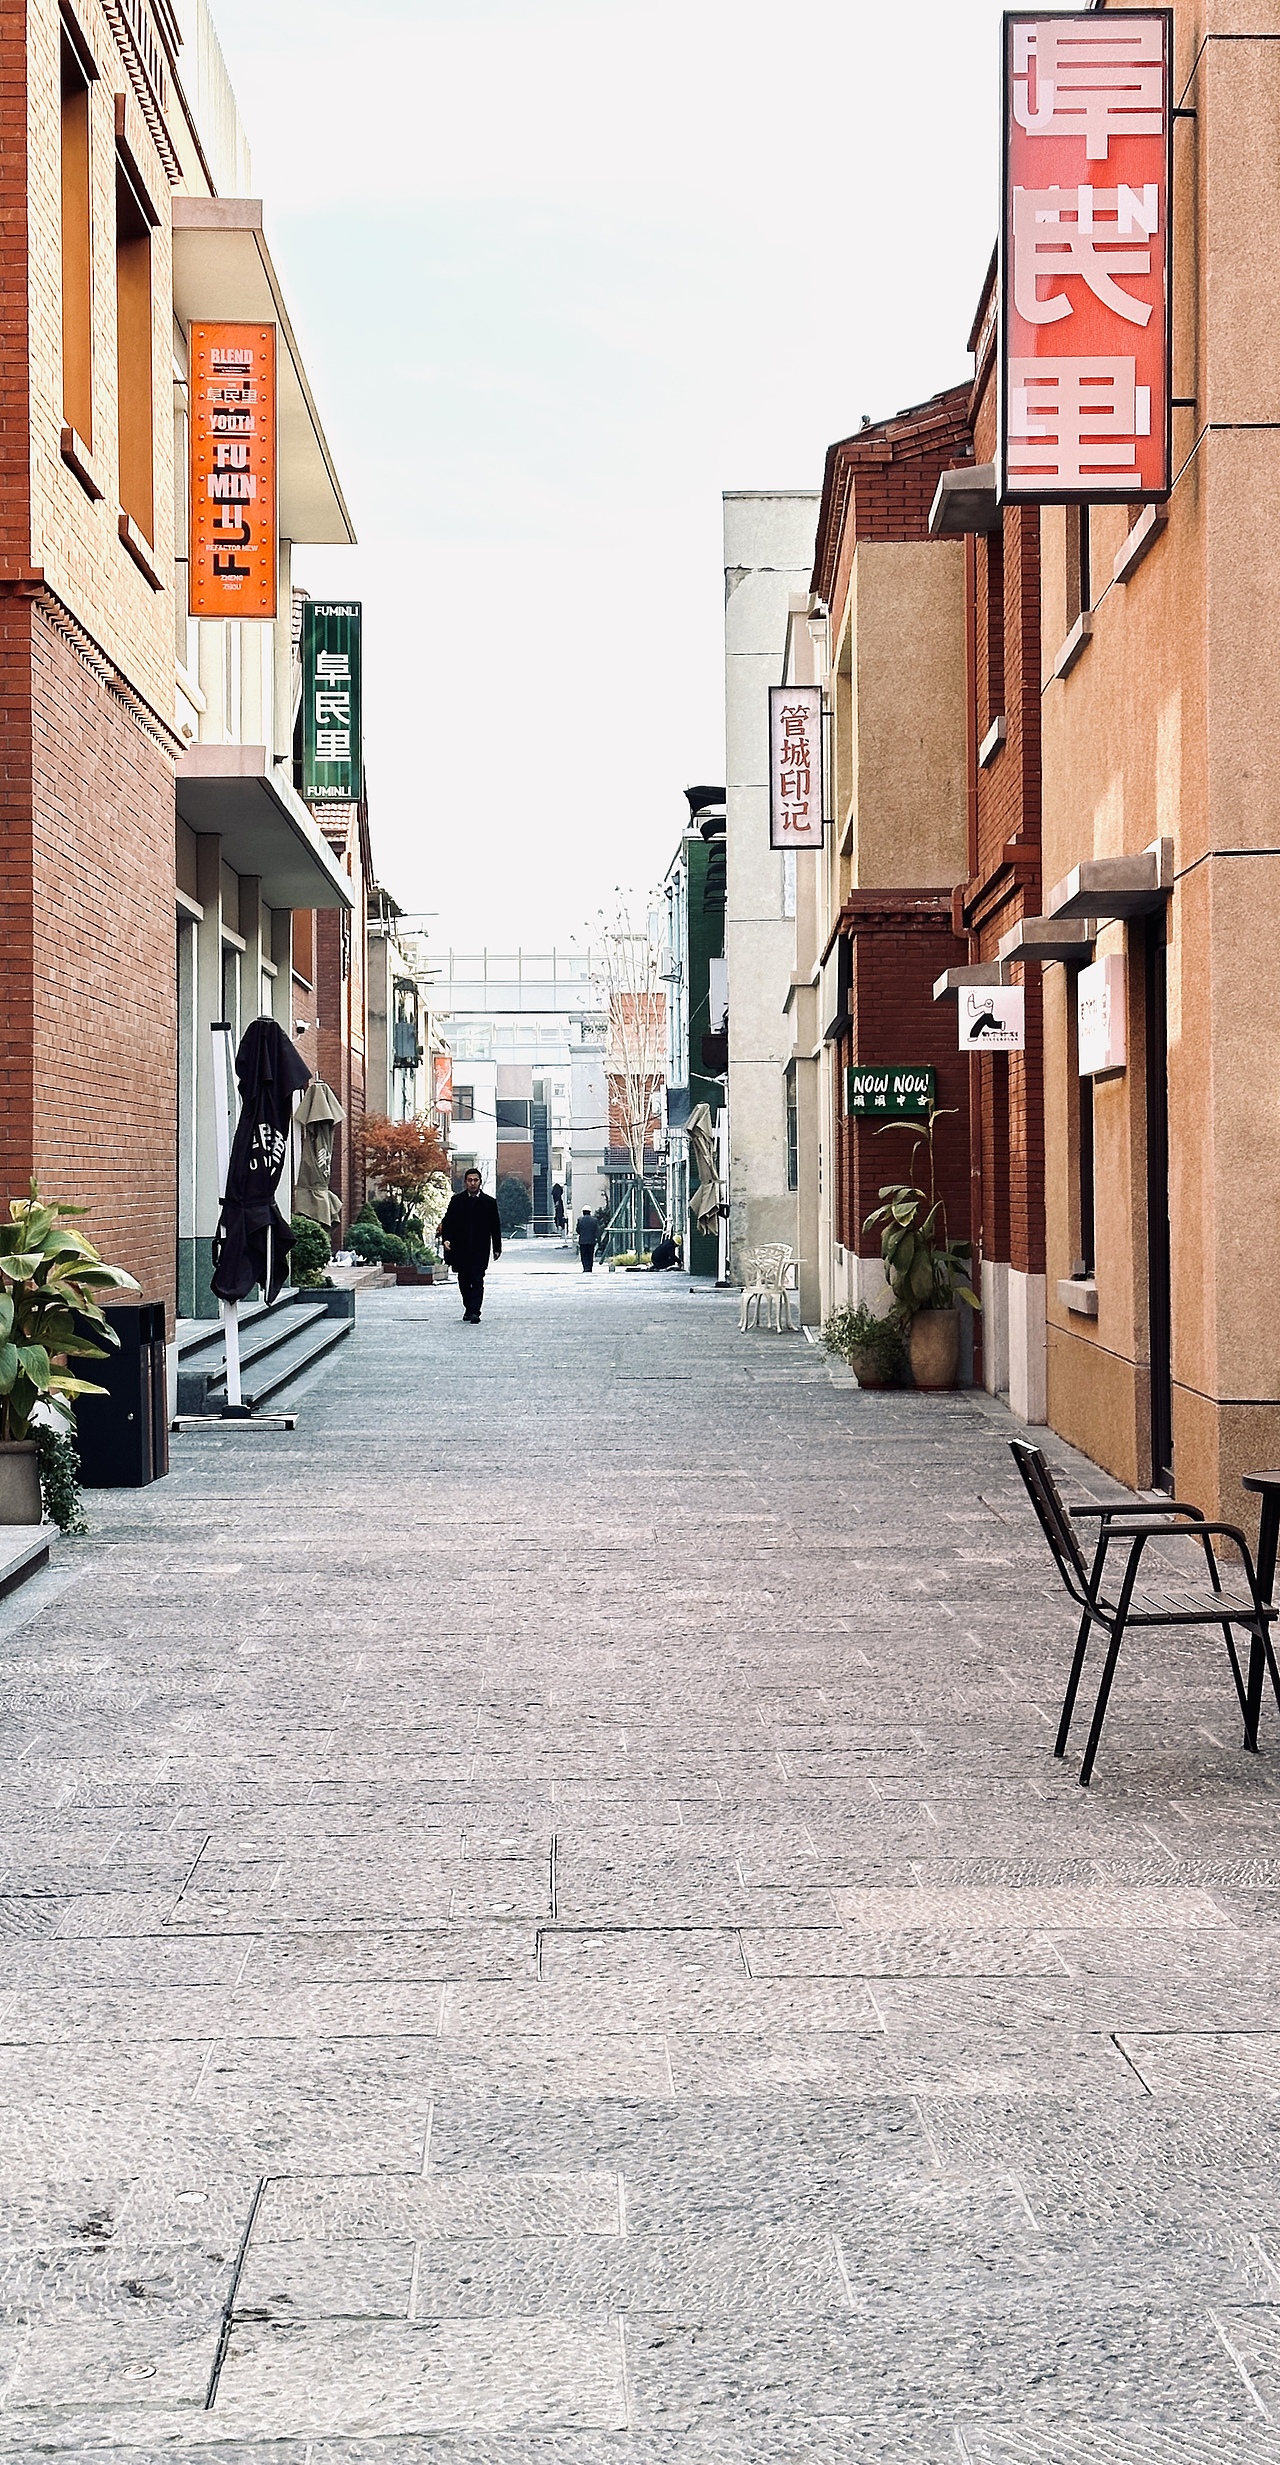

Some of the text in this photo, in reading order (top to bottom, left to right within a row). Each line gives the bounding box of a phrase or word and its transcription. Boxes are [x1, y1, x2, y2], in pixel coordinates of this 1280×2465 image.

[1008, 20, 1163, 488] 阜民里
[210, 348, 254, 364] BLEND
[206, 387, 258, 404] 阜民里
[209, 414, 255, 430] YOUTH
[217, 443, 247, 469] FU
[207, 473, 257, 498] MIN
[221, 504, 243, 529] LI
[314, 605, 359, 617] FUMINLI
[314, 649, 352, 762] 阜民里
[779, 704, 812, 832] 管城印记
[307, 785, 352, 797] FUMINLI
[853, 1074, 889, 1093] NOW
